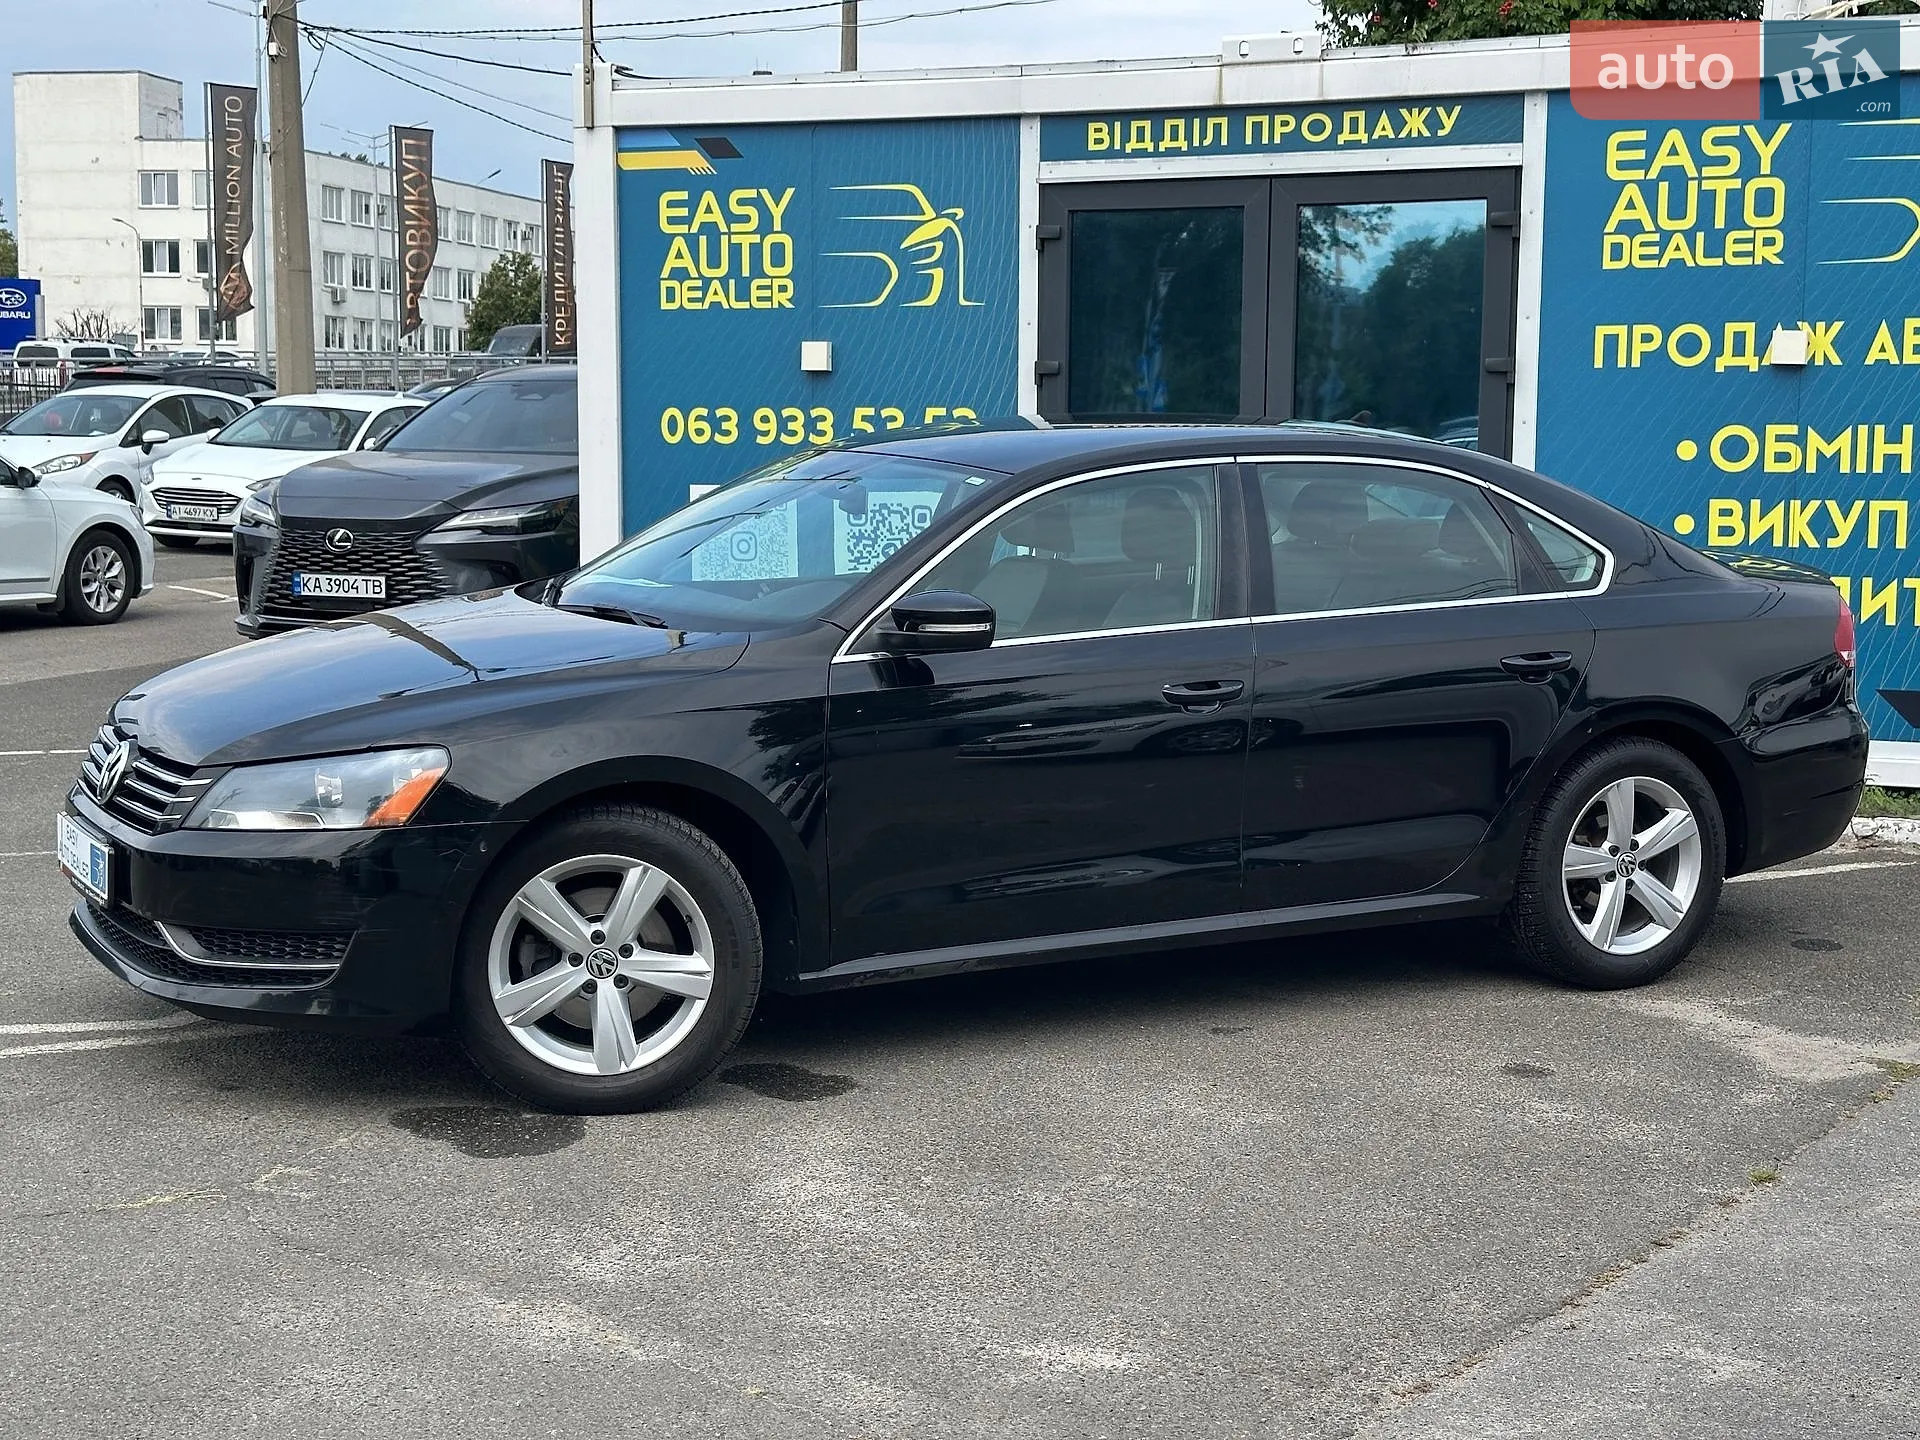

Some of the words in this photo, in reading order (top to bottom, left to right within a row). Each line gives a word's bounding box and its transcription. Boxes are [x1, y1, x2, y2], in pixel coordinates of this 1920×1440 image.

[224, 95, 243, 159] AUTO
[1086, 116, 1229, 154] ВІДДІЛ
[1245, 105, 1463, 146] ПРОДАЖУ
[1605, 122, 1793, 181] EASY
[224, 164, 241, 255] MILLION
[659, 187, 796, 234] EASY
[1603, 176, 1786, 234] AUTO
[660, 233, 795, 279] AUTO
[1602, 228, 1785, 270] DEALER
[659, 277, 796, 311] DEALER
[661, 406, 739, 445] 063
[752, 406, 835, 446] 933
[1709, 423, 1914, 474] ОБМІН
[1707, 498, 1909, 550] ВИКУП
[301, 576, 323, 593] KA
[325, 577, 359, 594] 3904
[361, 578, 383, 595] TB
